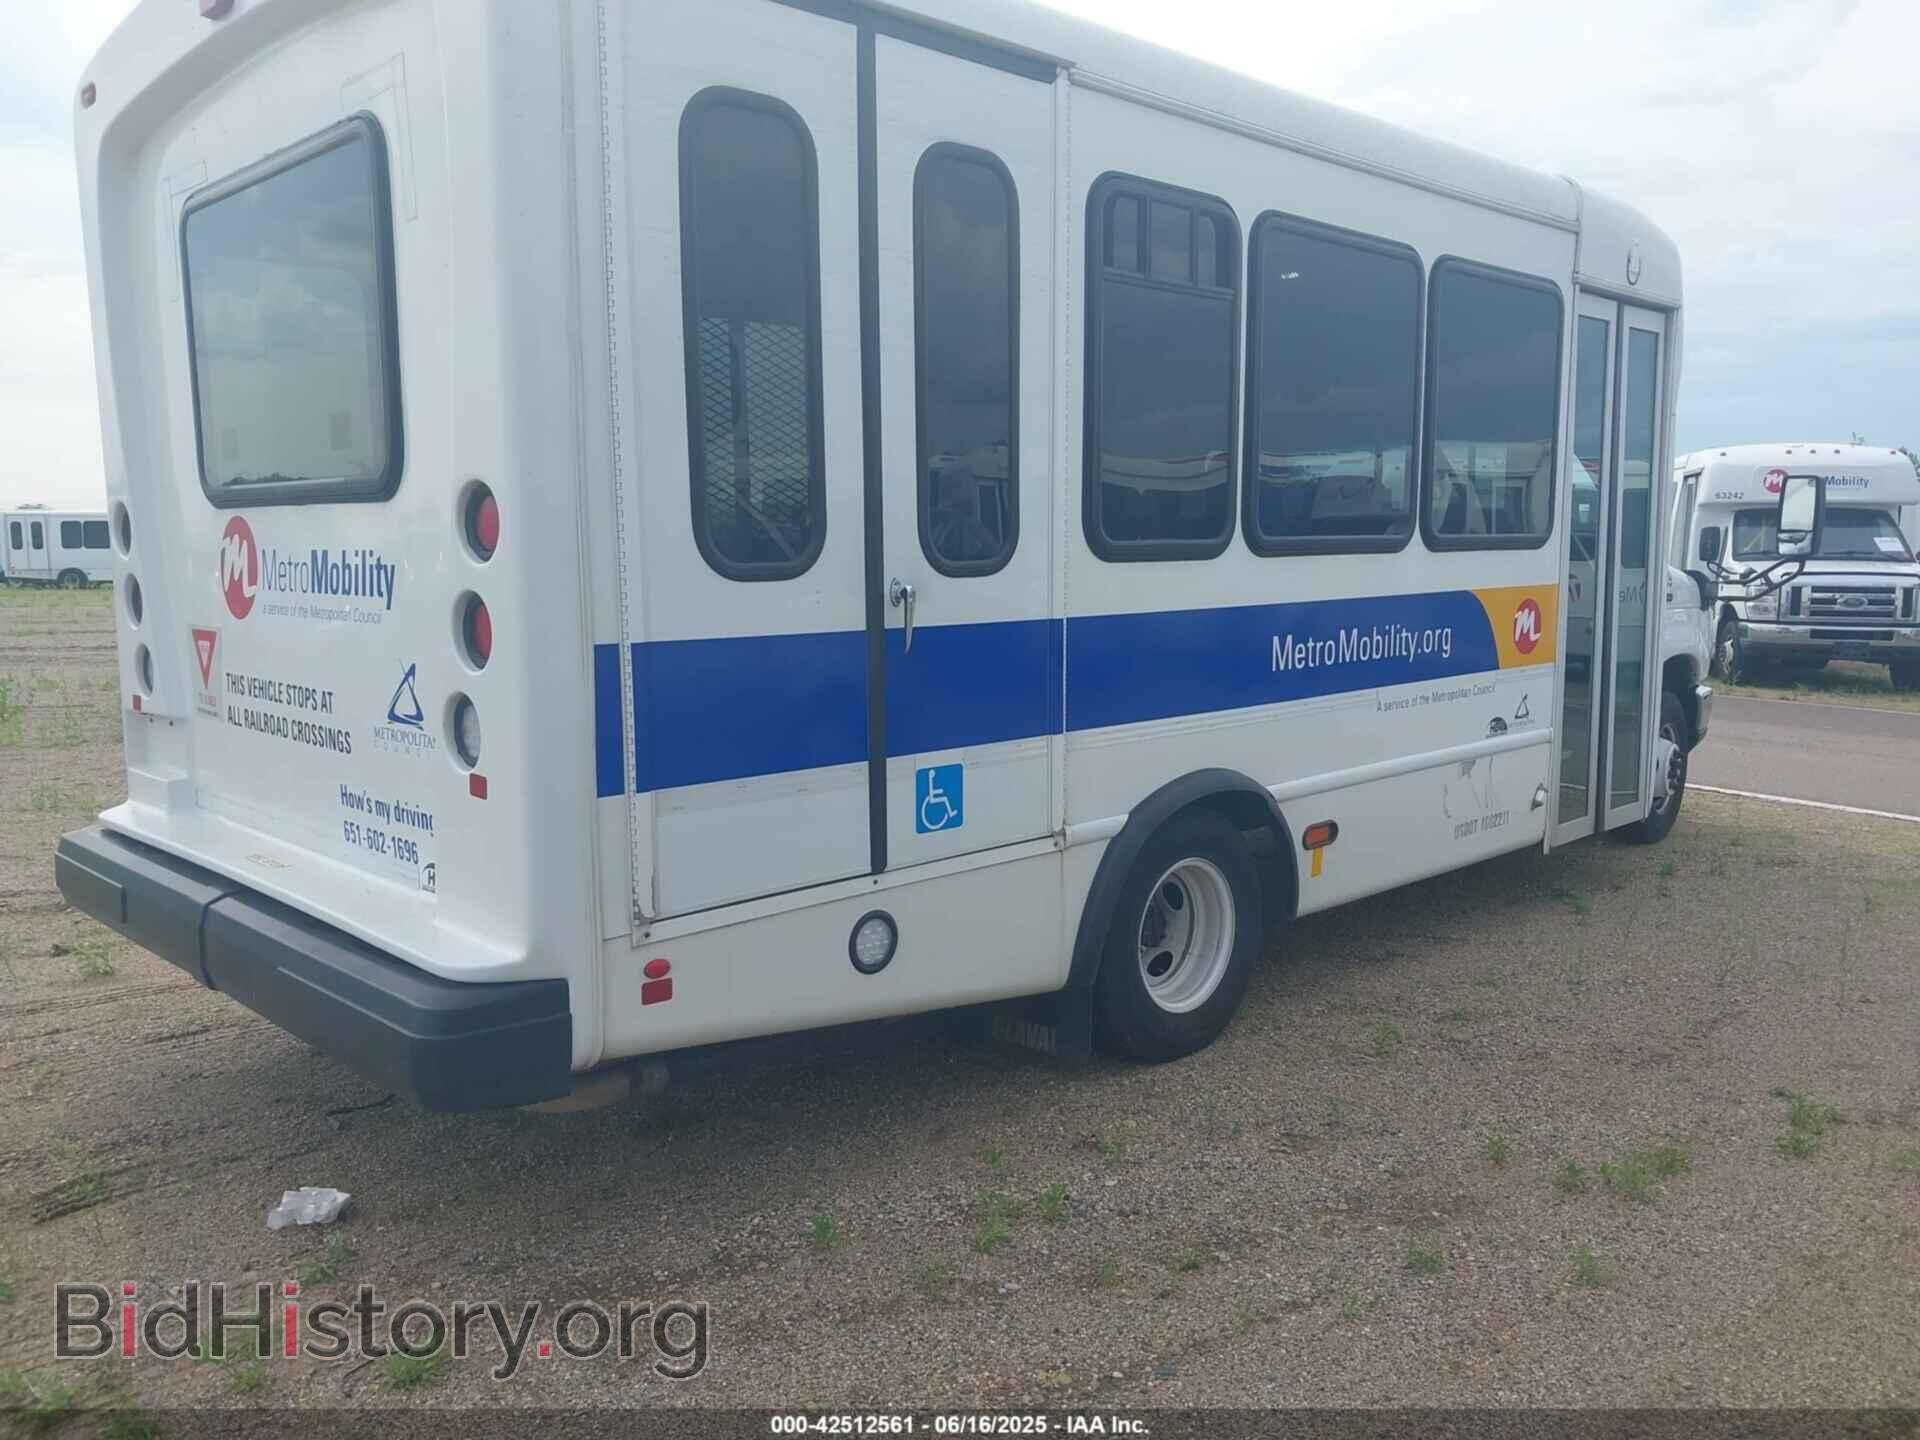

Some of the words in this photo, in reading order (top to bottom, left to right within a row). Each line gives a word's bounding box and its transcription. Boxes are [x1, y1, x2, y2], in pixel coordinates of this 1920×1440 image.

[261, 548, 396, 611] MetroMobility
[1272, 623, 1452, 673] MetroMobility.org
[225, 672, 245, 696] THIS
[247, 676, 283, 704] VEHICLE
[286, 683, 318, 711] STOPS
[321, 690, 333, 714] AT
[227, 705, 242, 727] ALL
[244, 708, 289, 739] RAILROAD
[291, 719, 352, 754] CROSSINGS
[339, 784, 373, 814] How's
[375, 800, 391, 825] my
[343, 820, 419, 865] 651-602-1696
